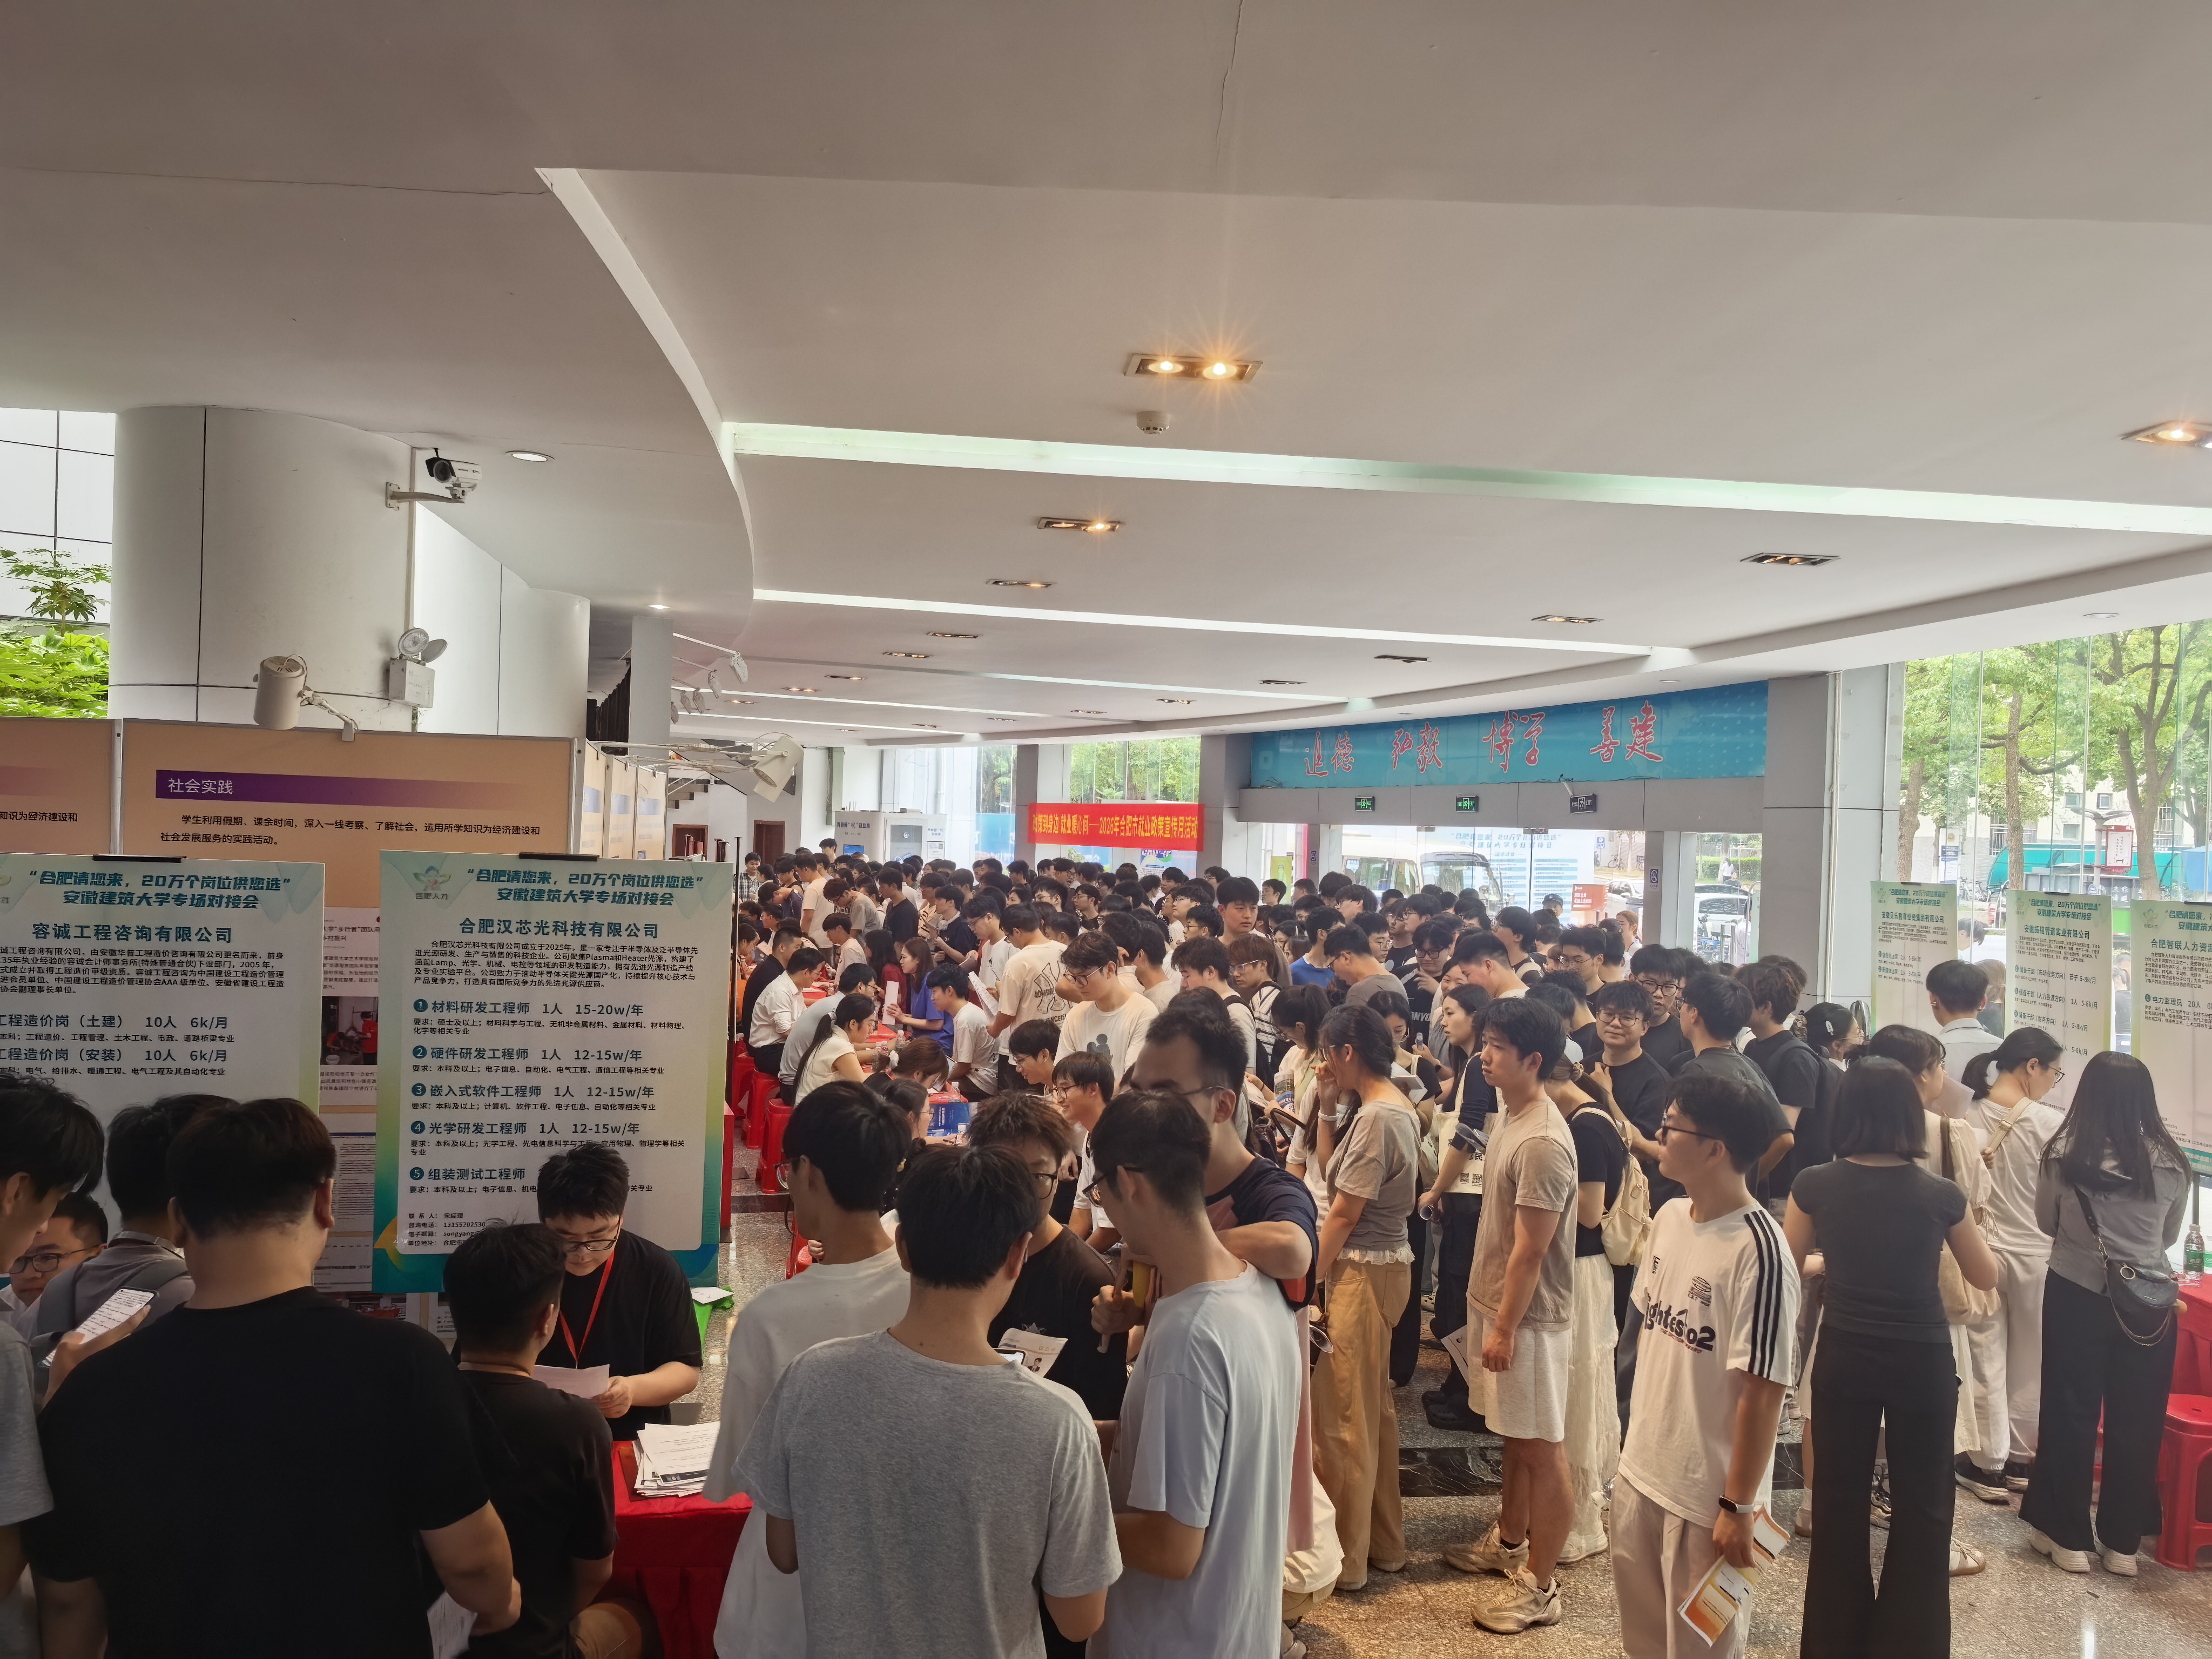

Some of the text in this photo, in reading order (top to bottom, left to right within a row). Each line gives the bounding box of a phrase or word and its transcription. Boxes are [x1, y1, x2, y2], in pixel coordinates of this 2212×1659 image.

[168, 777, 233, 794] 社会实践
[181, 814, 541, 835] 学生利用假期、课余时间，深入一线考察、了解社会，运用所学知识为经济建设和
[160, 832, 278, 845] 社会发展服务的实践活动。
[63, 891, 259, 909] 安徽建筑大学专场对接会
[497, 887, 675, 906] 安徽建筑大学专场对接会
[32, 922, 232, 943] 容诚工程咨询有限公司
[459, 918, 658, 939] 合肥汉芯光科技有限公司
[431, 1000, 530, 1014] 材料研发工程师
[542, 1002, 563, 1015] 1人
[575, 1004, 644, 1017] 15-20w/年
[145, 1016, 177, 1029] 10人
[190, 1016, 228, 1030] 6k/月
[413, 1027, 470, 1035] 化学等相关专业
[144, 1049, 177, 1062] 10人
[190, 1049, 227, 1063] 6k/月
[430, 1047, 529, 1060] 硬件研发工程师
[541, 1048, 562, 1060] 1人
[574, 1049, 642, 1062] 12-15w/年
[430, 1084, 541, 1097] 嵌入式软件工程师
[554, 1085, 574, 1097] 1人
[586, 1086, 655, 1099] 12-15w/年
[429, 1122, 527, 1135] 光学研发工程师
[539, 1122, 559, 1135] 1人
[571, 1122, 640, 1136] 12-15w/年
[428, 1168, 526, 1181] 组装测试工程师
